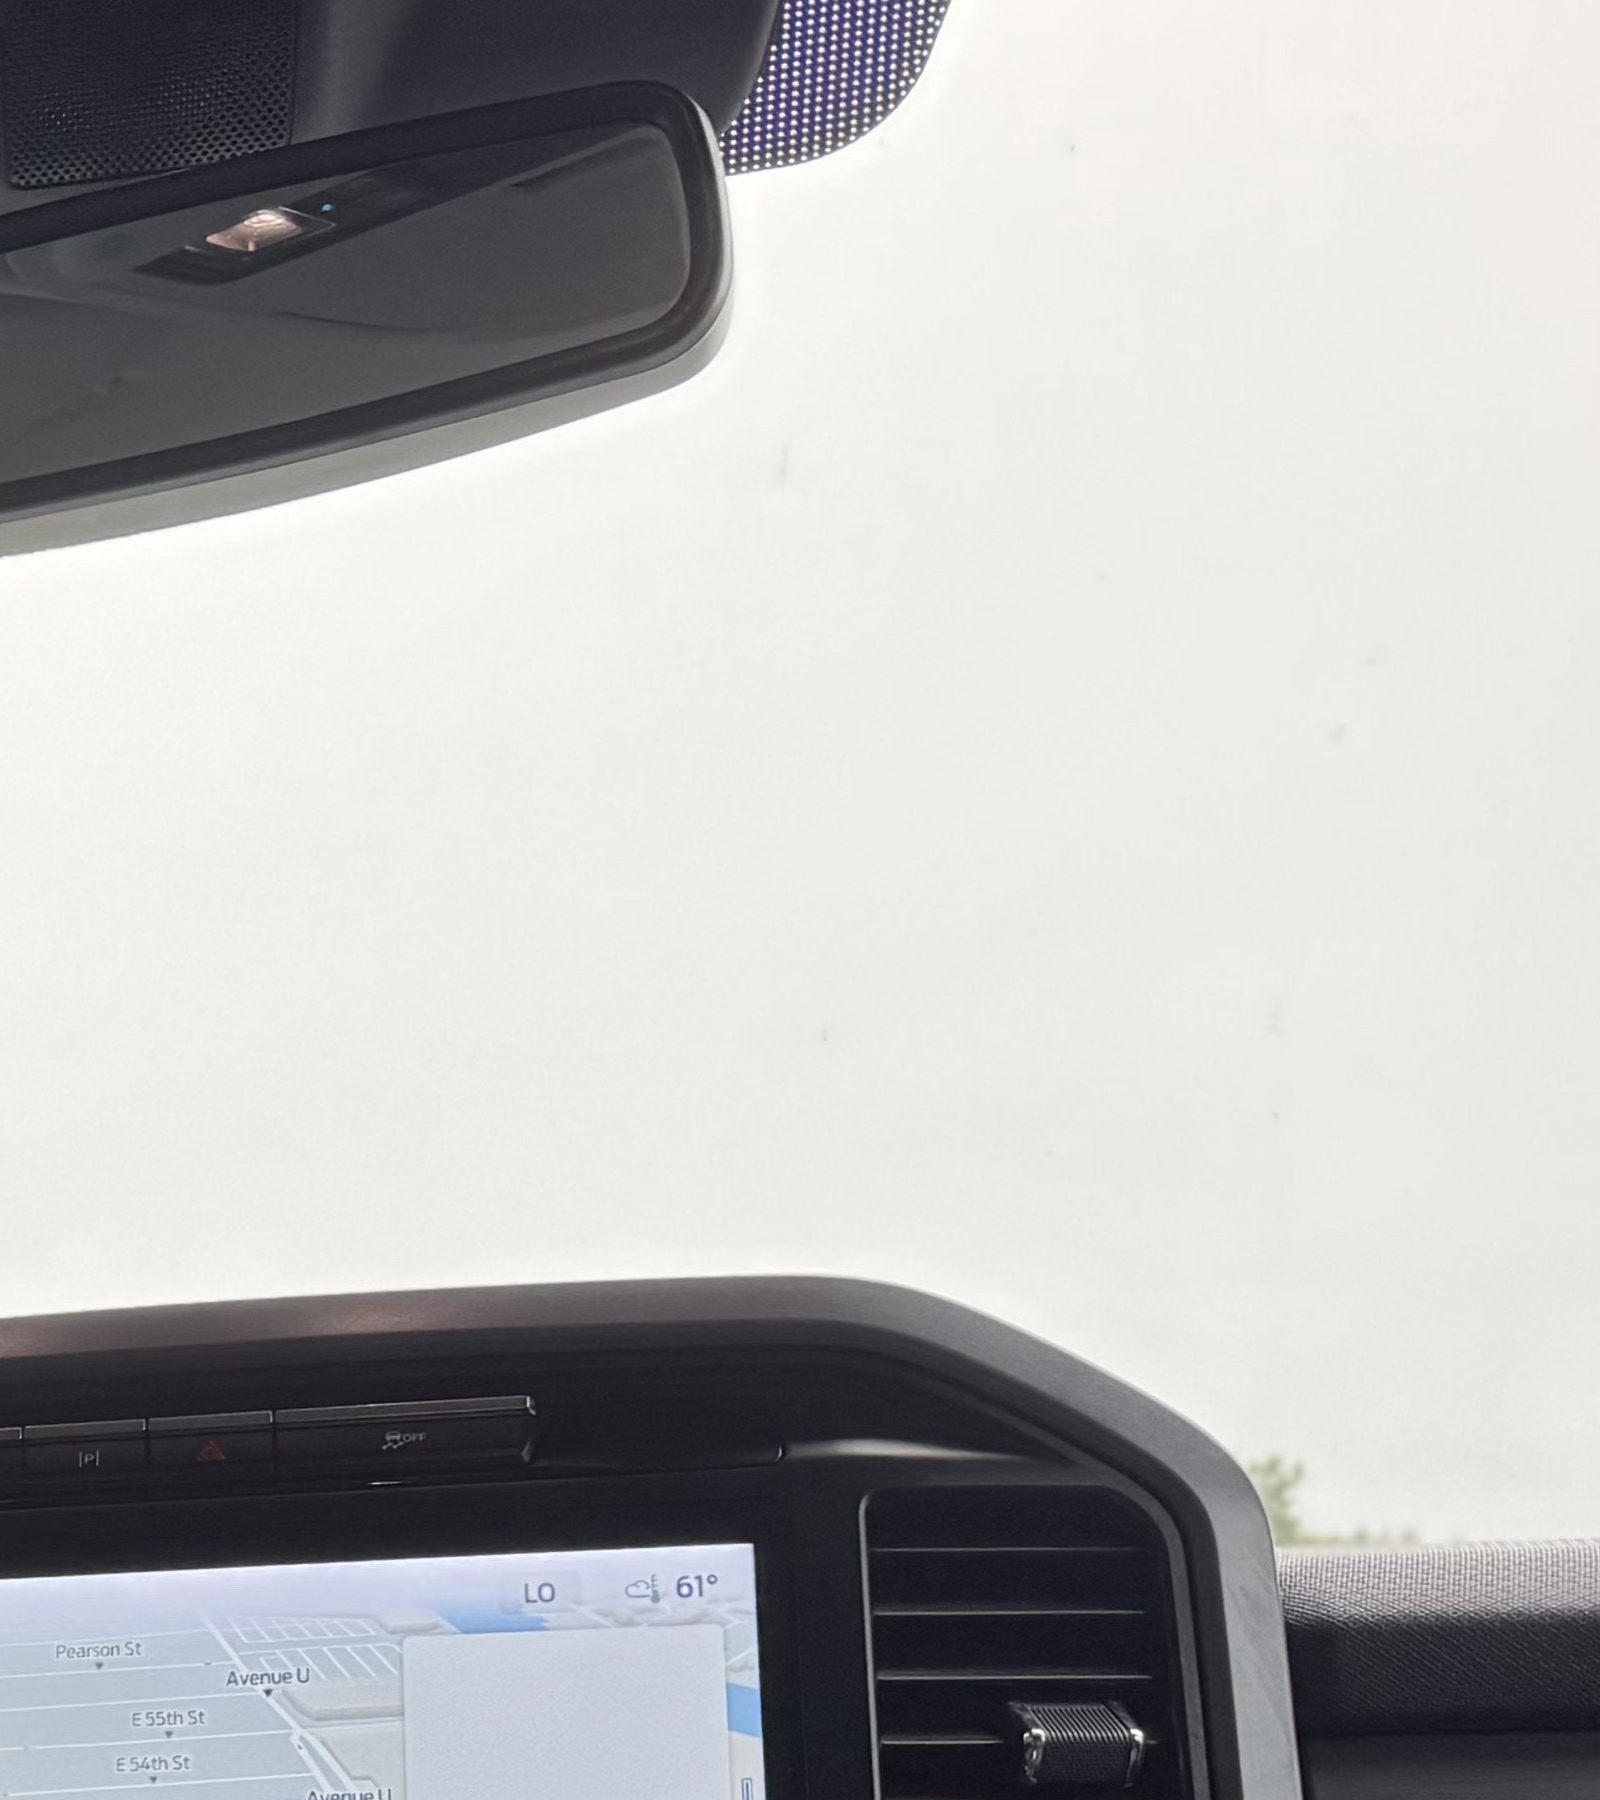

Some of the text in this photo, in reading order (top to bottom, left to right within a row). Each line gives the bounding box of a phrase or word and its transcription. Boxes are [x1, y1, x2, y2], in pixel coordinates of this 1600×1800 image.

[402, 1433, 427, 1443] OFF
[524, 1583, 555, 1603] LO
[56, 1641, 142, 1659] Pearson St
[227, 1668, 309, 1686] Avenue U
[132, 1710, 206, 1726] E 55th St
[117, 1755, 190, 1772] E 54th St
